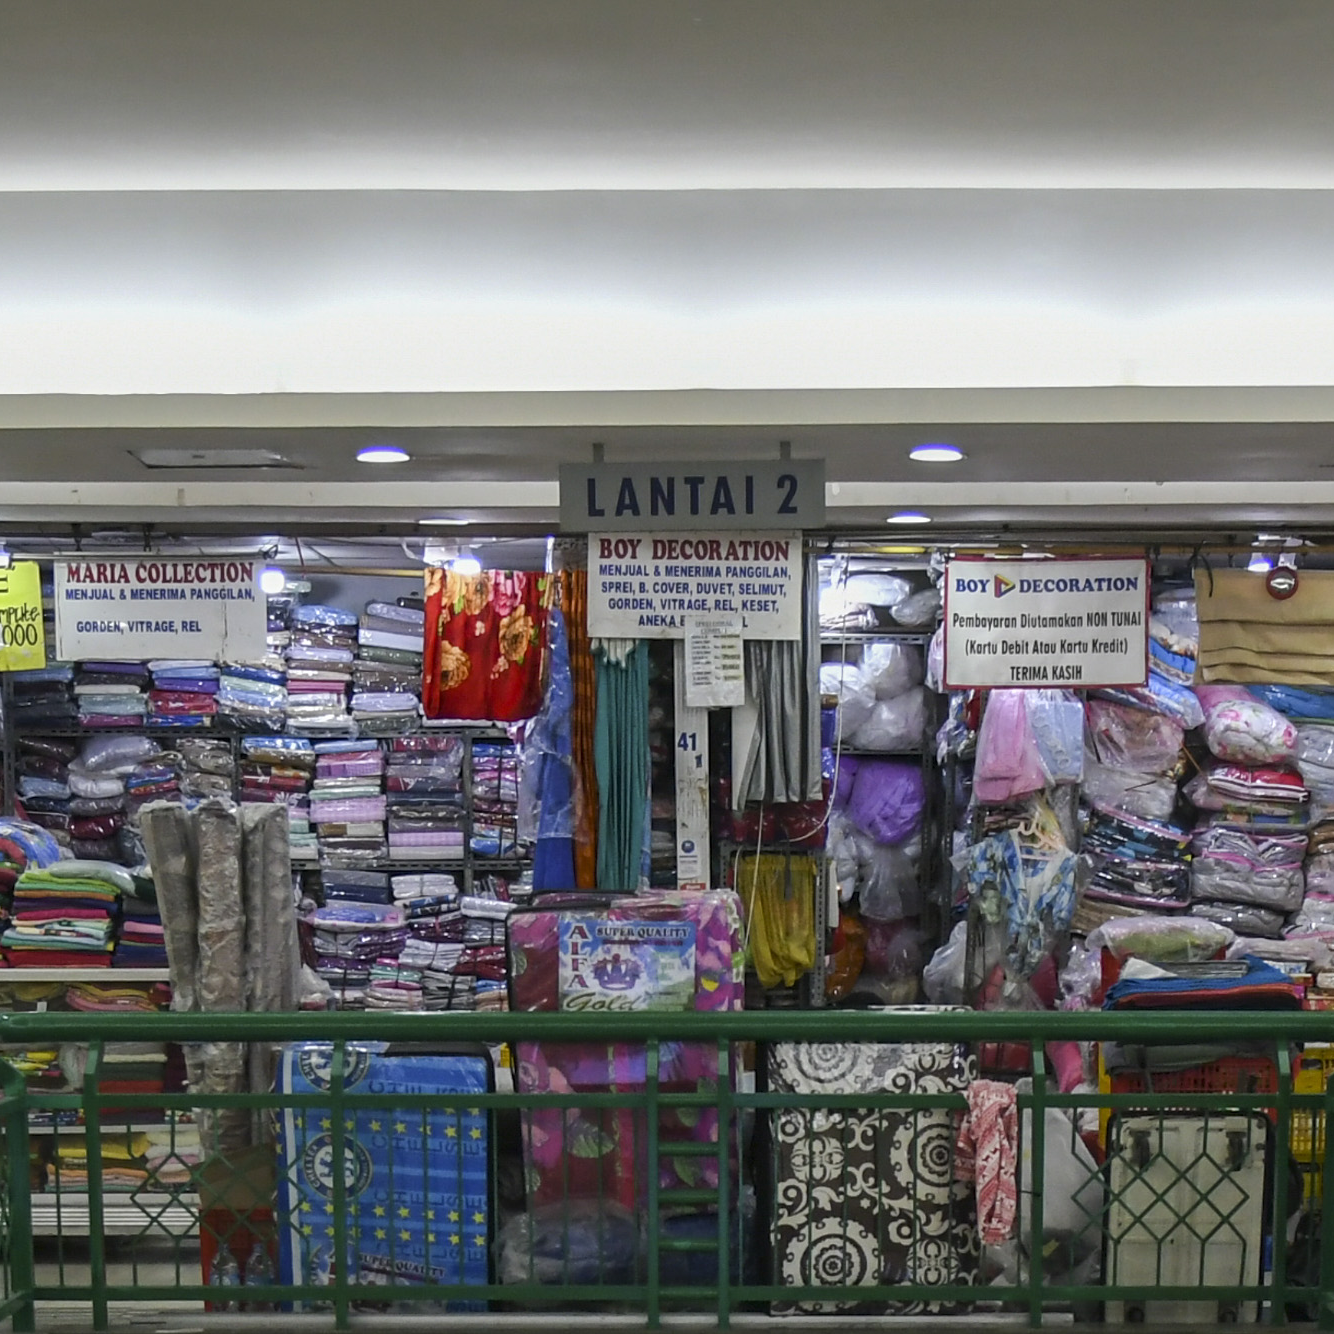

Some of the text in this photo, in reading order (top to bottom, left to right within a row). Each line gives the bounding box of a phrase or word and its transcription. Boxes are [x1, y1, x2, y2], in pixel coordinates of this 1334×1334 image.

[587, 474, 798, 517] LANTAI 2
[599, 538, 790, 561] BOY DECORATION
[67, 562, 254, 584] MARIA COLLECTION
[599, 564, 791, 580] MENJUAL & MENERIMA PANGGILAN,
[601, 581, 787, 598] SPREI, B. COVER, DUVET, SELIMUT,
[955, 577, 1139, 593] BOY DECORATION
[65, 588, 256, 602] MENJUAL & MENERIMA PANGGILAN,
[608, 598, 780, 614] GORDEN, VITRAGE, REL, KESET,
[76, 620, 202, 635] GORDEN, VITRAGE, REL
[638, 614, 677, 627] ANEKA
[952, 611, 1142, 632] Pembayaran Diutamakan NON TUNAI
[965, 638, 1128, 656] (Kartu Debit Atau Kartu Kredit)
[1010, 665, 1082, 681] TERIMA KASIH
[677, 732, 697, 751] 41
[596, 926, 690, 940] SUPER QUALITY
